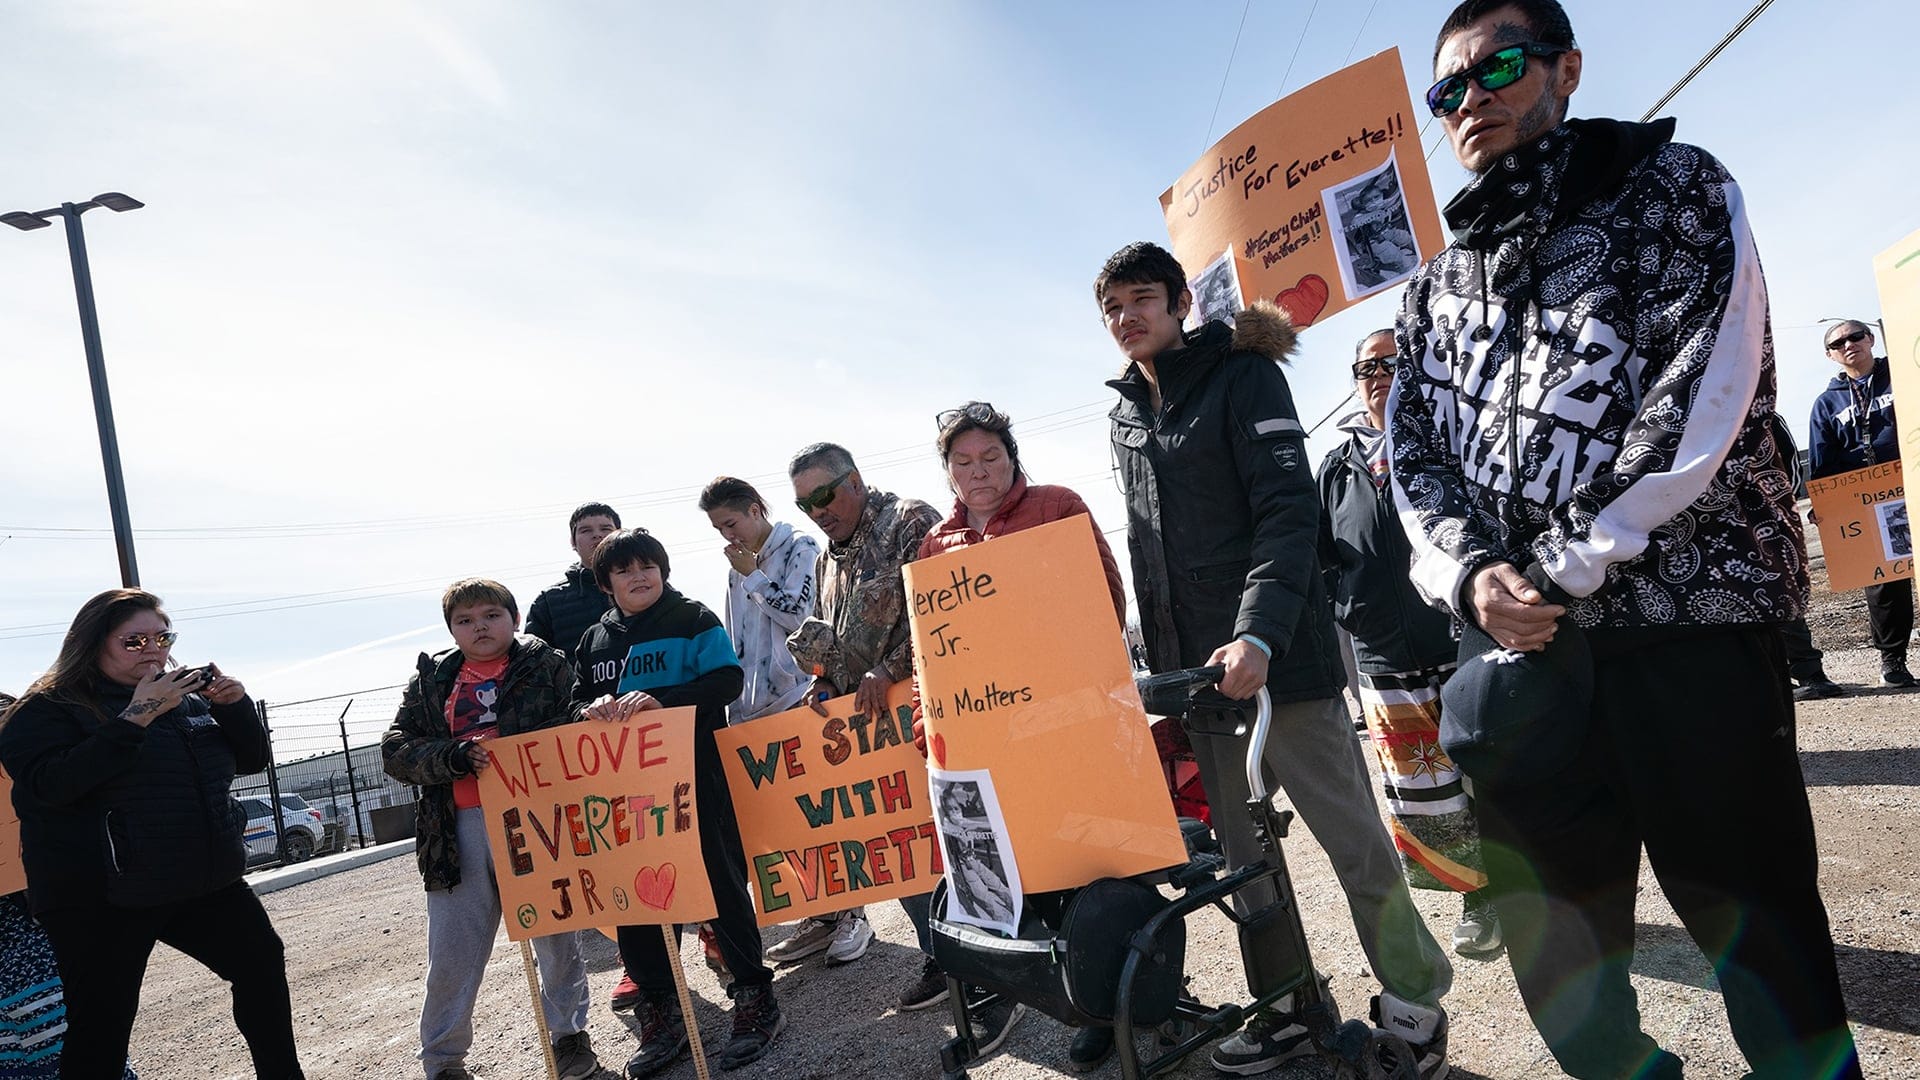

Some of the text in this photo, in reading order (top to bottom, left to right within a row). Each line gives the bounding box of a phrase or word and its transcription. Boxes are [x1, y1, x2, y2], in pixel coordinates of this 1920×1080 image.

[1184, 145, 1257, 218] Justice
[1242, 112, 1404, 200] For Everette!!
[1262, 220, 1321, 269] Matters!!
[1839, 520, 1862, 539] IS
[1874, 566, 1885, 580] A
[591, 650, 667, 684] ZOO YORK
[954, 681, 1033, 717] Matters
[487, 722, 668, 799] WE LOVE
[736, 736, 806, 791] WE
[795, 770, 912, 829] WITH
[502, 781, 692, 877] EVERETTE
[551, 867, 605, 921] JR
[1392, 1015, 1416, 1031] PUMA
